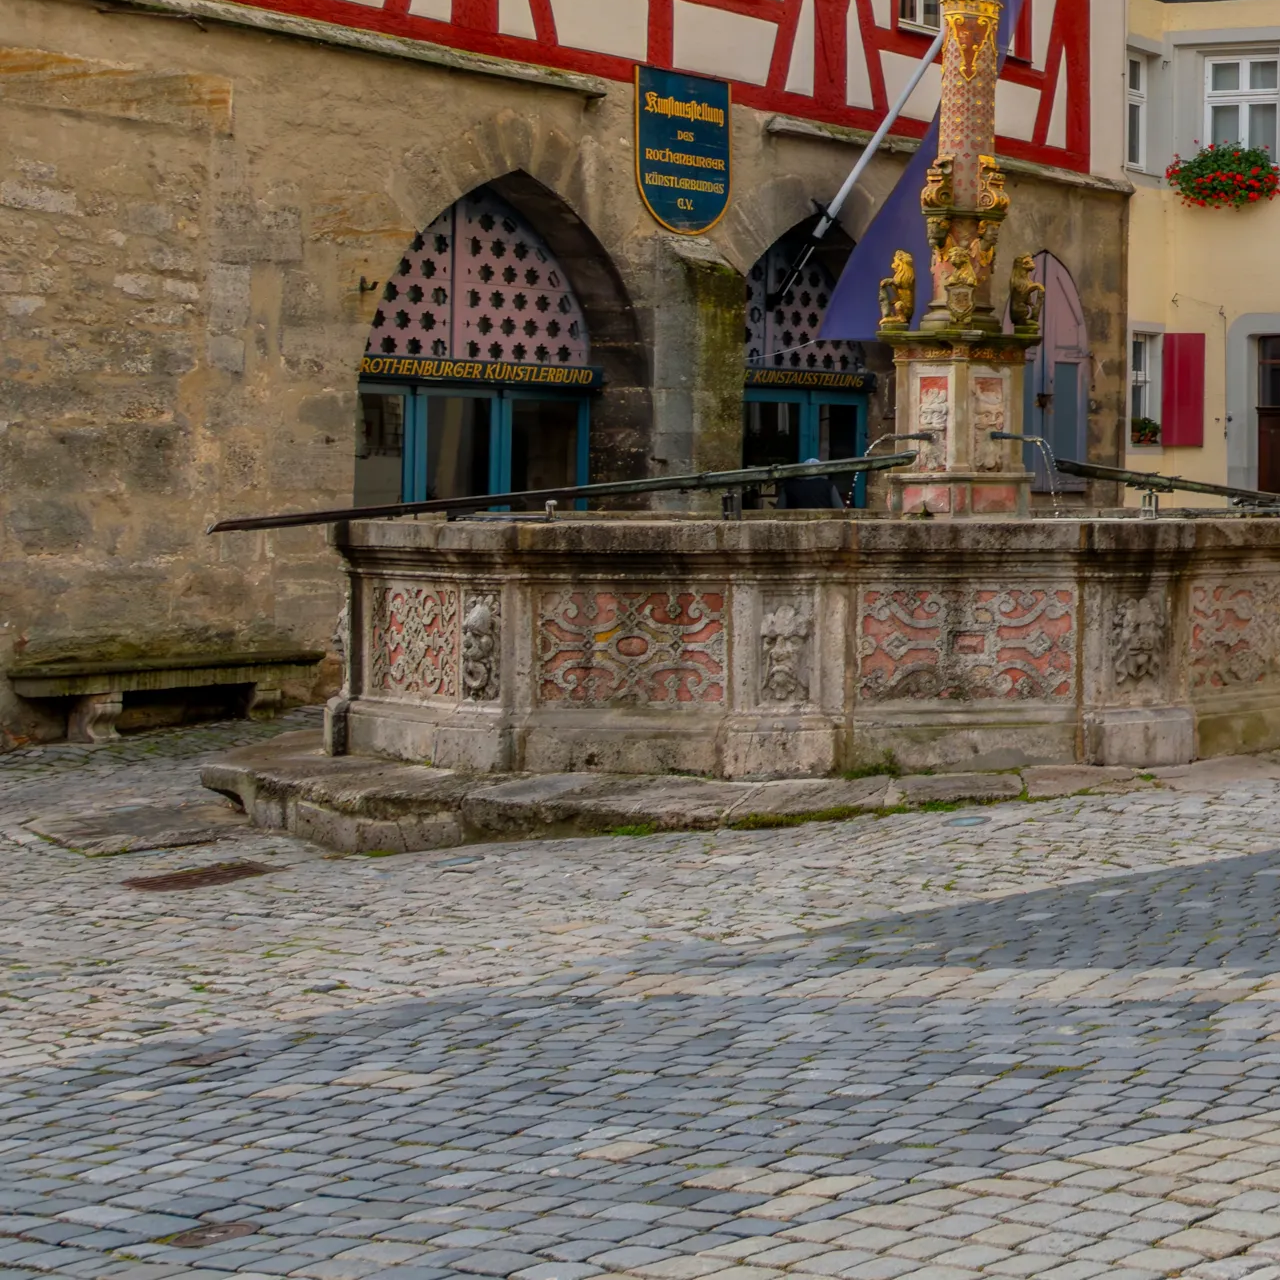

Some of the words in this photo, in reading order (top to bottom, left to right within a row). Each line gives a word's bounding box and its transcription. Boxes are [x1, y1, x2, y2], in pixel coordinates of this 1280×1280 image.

[677, 130, 694, 142] DES
[645, 172, 725, 194] KÜNSTLERBUNDES
[361, 357, 482, 379] ROTHENBURGER
[484, 362, 593, 385] KÜNSTLERBUND
[753, 369, 864, 388] KUNSTAUSSTELLUNG
